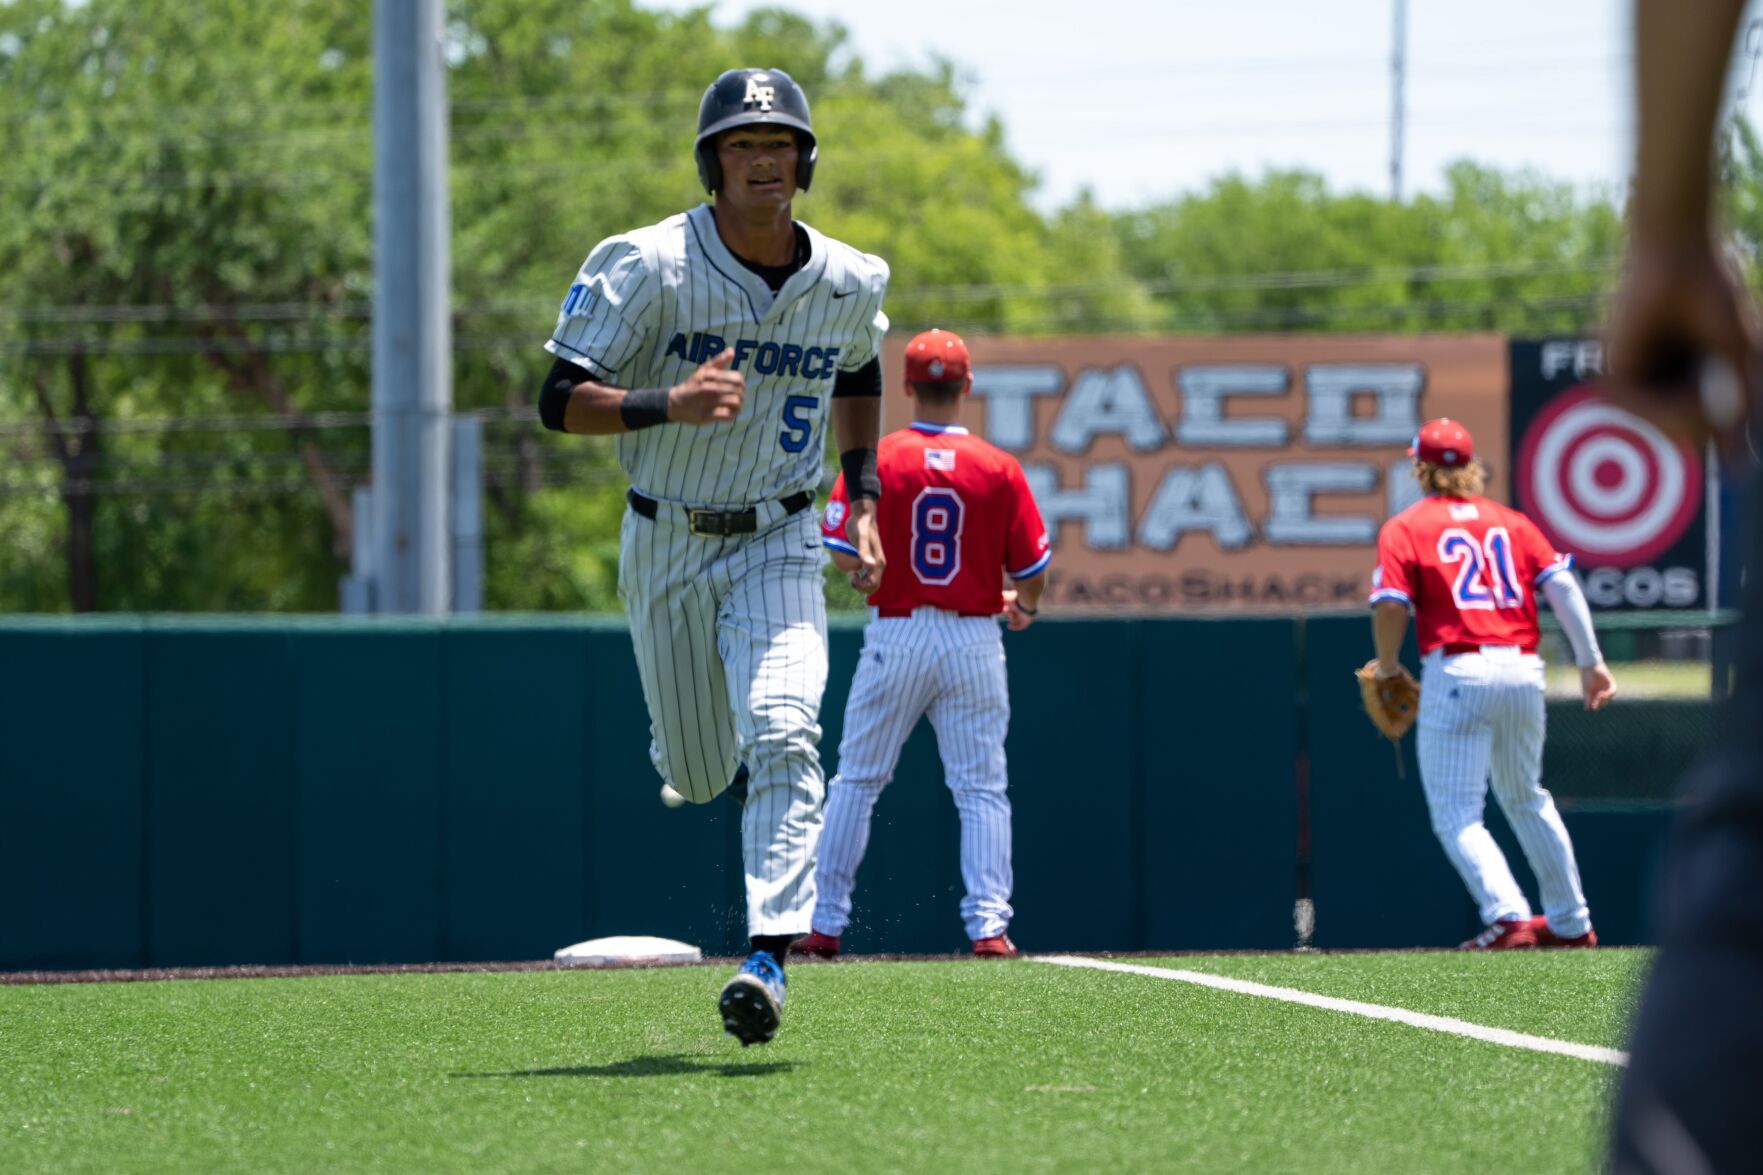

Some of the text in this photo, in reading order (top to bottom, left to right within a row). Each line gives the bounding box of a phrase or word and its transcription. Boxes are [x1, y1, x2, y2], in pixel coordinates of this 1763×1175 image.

[665, 332, 840, 380] AIR FORCE
[779, 395, 818, 453] 5
[971, 363, 1425, 453] TACO
[911, 486, 965, 586] 8
[1022, 461, 1420, 552] HAC
[1437, 527, 1523, 610] 21
[1572, 566, 1698, 607] COS
